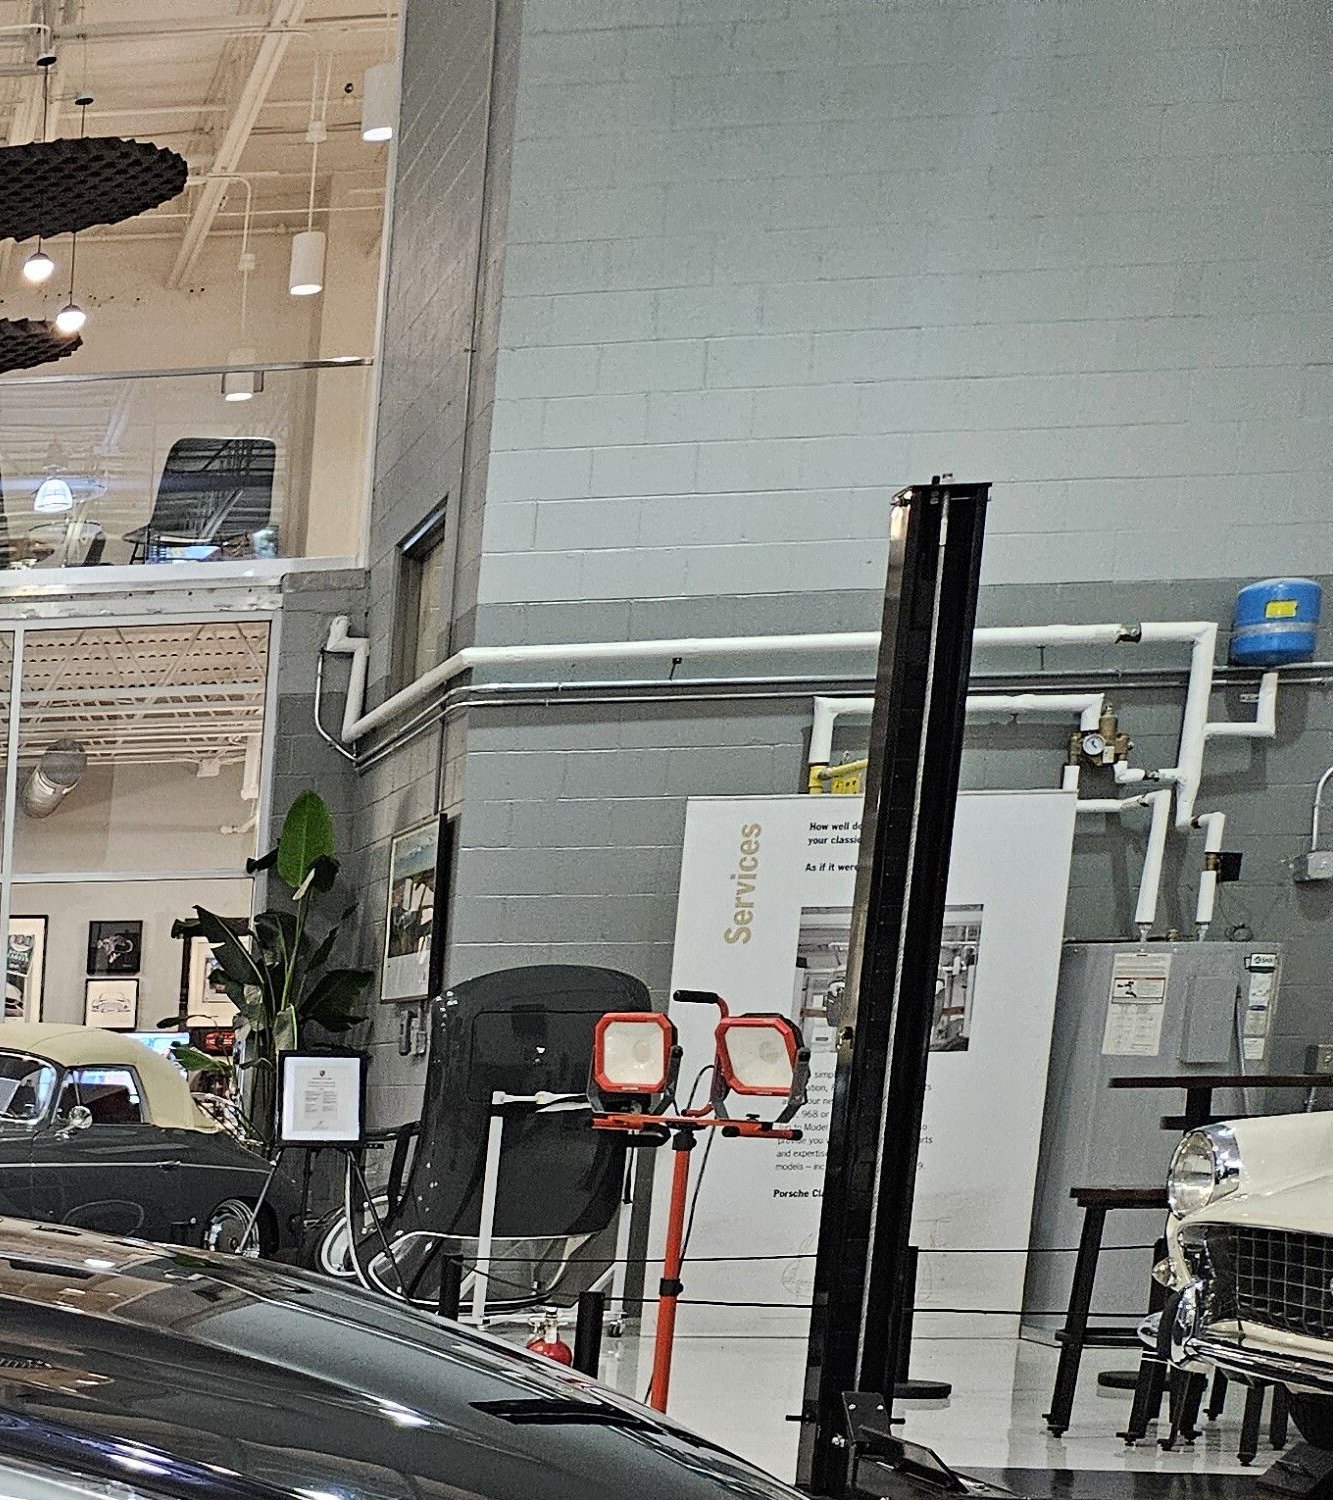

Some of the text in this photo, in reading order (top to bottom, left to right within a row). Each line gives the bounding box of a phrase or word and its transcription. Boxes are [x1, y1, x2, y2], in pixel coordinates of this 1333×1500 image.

[809, 822, 829, 831] How
[832, 821, 850, 831] well
[808, 837, 828, 846] your
[805, 863, 817, 871] As
[819, 862, 827, 871] if
[828, 863, 835, 871] it
[724, 823, 762, 945] Services
[801, 1109, 819, 1119] 968
[776, 1149, 791, 1158] and
[775, 1162, 804, 1171] models
[773, 1189, 809, 1198] Porsche
